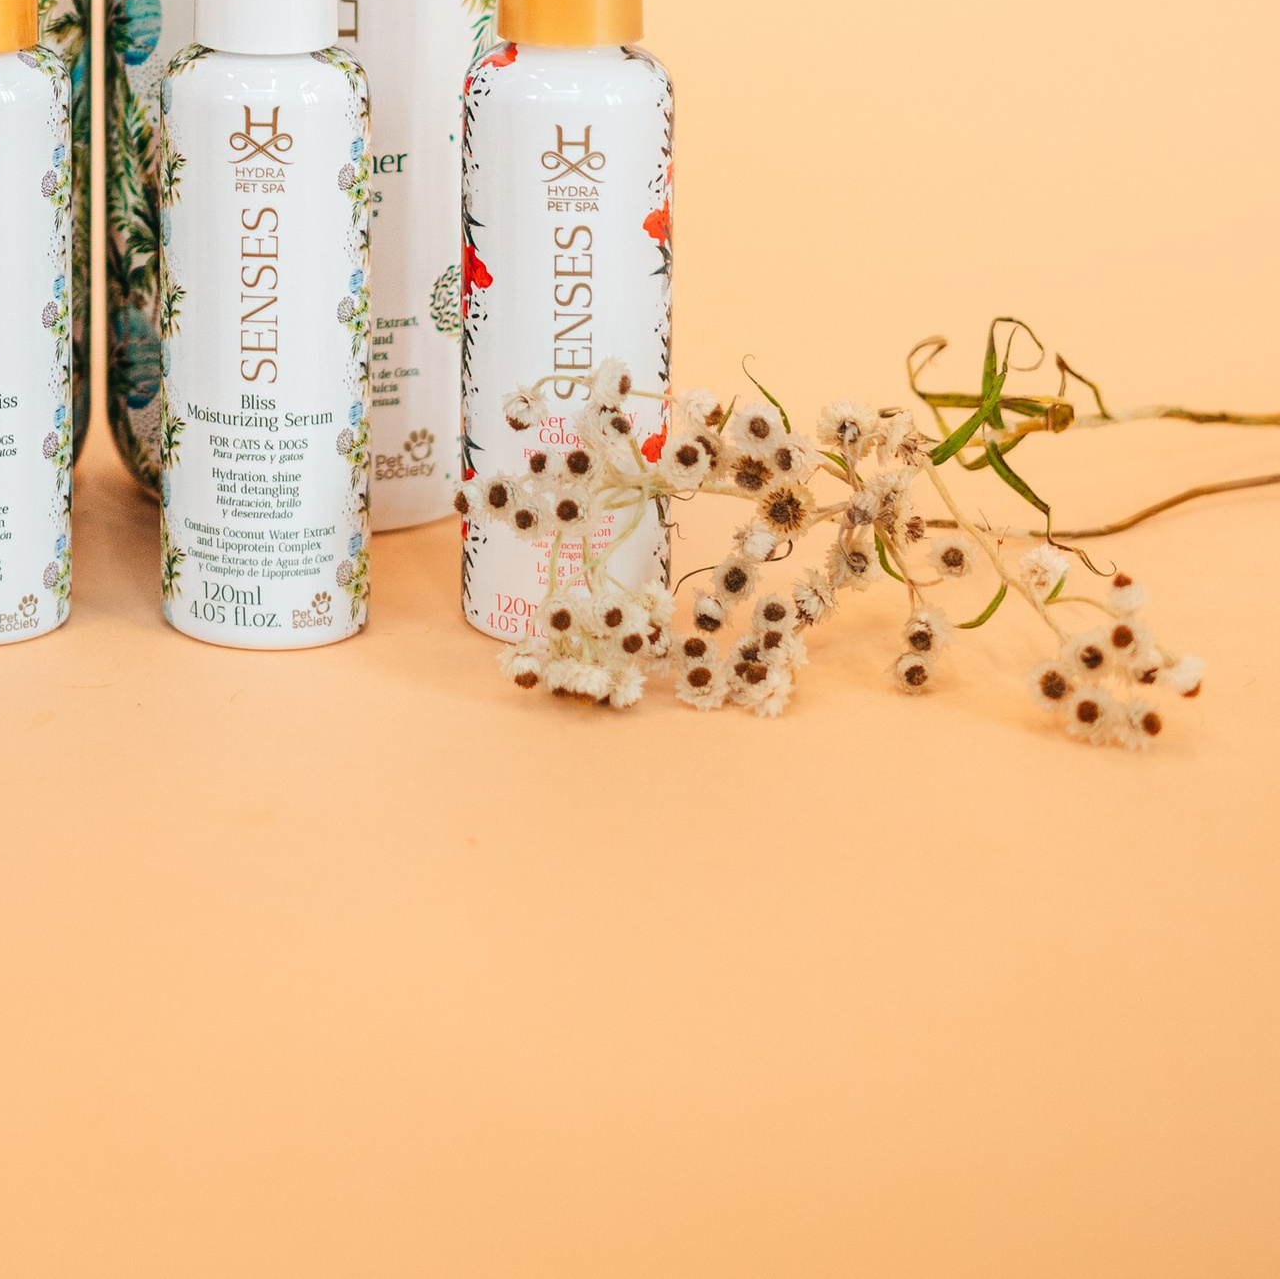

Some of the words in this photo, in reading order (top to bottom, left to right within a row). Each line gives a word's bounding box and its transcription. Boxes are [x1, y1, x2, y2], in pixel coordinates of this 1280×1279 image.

[235, 166, 286, 178] HYDRA
[235, 182, 258, 192] PET
[261, 183, 286, 193] SPA
[547, 185, 599, 197] HYDRA
[547, 201, 571, 212] PET
[575, 201, 599, 212] SPA
[240, 206, 279, 384] SENSES
[240, 393, 276, 411] Bliss
[187, 402, 279, 433] Moisturizing
[284, 411, 333, 428] Serum
[209, 434, 230, 448] FOR
[232, 438, 261, 450] CATS
[264, 439, 274, 451] &
[278, 438, 309, 450] DOGS
[538, 427, 586, 449] Colog
[212, 448, 233, 460] Para
[235, 452, 266, 463] perros
[269, 454, 277, 464] y
[278, 452, 304, 464] gatos
[375, 453, 403, 469] Pet
[211, 467, 269, 484] Hydration,
[272, 471, 302, 482] shine
[375, 461, 436, 482] society
[216, 482, 237, 493] and
[240, 483, 300, 498] detangling
[275, 498, 302, 508] brillo
[221, 508, 228, 519] y
[230, 507, 294, 519] desenredado
[184, 517, 220, 536] Contains
[222, 526, 265, 540] Coconut
[268, 528, 300, 540] Water
[303, 525, 336, 539] Extract
[196, 535, 213, 547] and
[216, 538, 275, 554] Lipoprotein
[278, 540, 322, 555] Complex
[187, 546, 220, 562] Contiene
[221, 553, 259, 567] Extracto
[260, 556, 273, 567] de
[275, 557, 301, 569] Agua
[301, 555, 313, 565] de
[314, 553, 334, 564] Coco
[198, 562, 204, 573] y
[205, 561, 245, 578] Complejo
[247, 567, 260, 578] de
[202, 580, 262, 605] 120ml
[189, 600, 226, 623] 4.05
[234, 605, 282, 628] fl.oz.
[292, 609, 312, 620] Pet
[292, 615, 334, 629] society
[486, 612, 518, 634] 4.05
